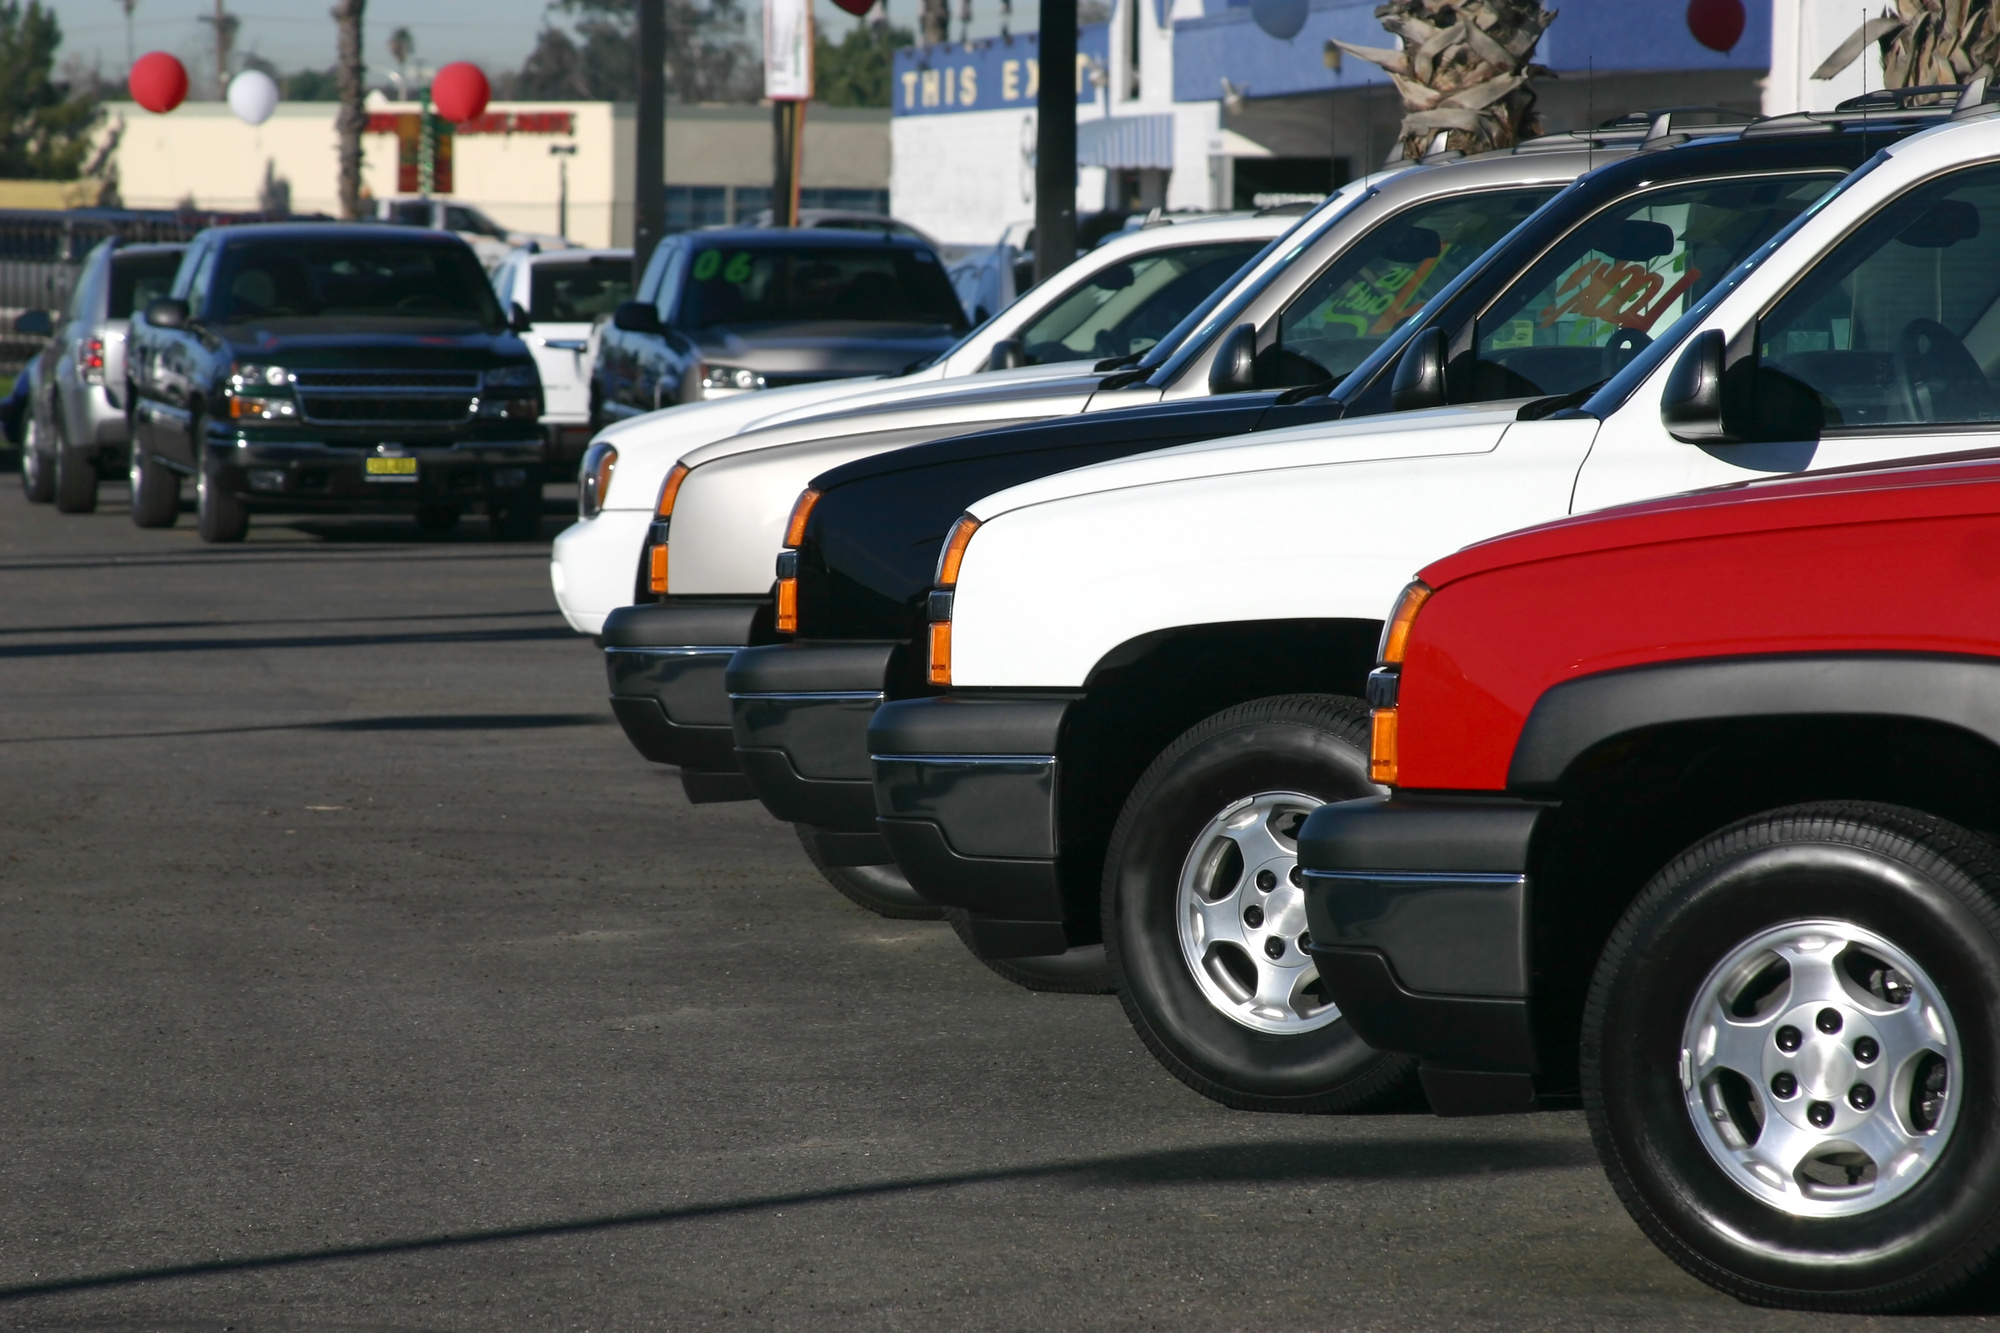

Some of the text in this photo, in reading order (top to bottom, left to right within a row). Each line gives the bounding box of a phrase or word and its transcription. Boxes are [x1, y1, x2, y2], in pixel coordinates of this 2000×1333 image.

[902, 52, 1090, 109] THIS EXT
[693, 249, 752, 284] 06
